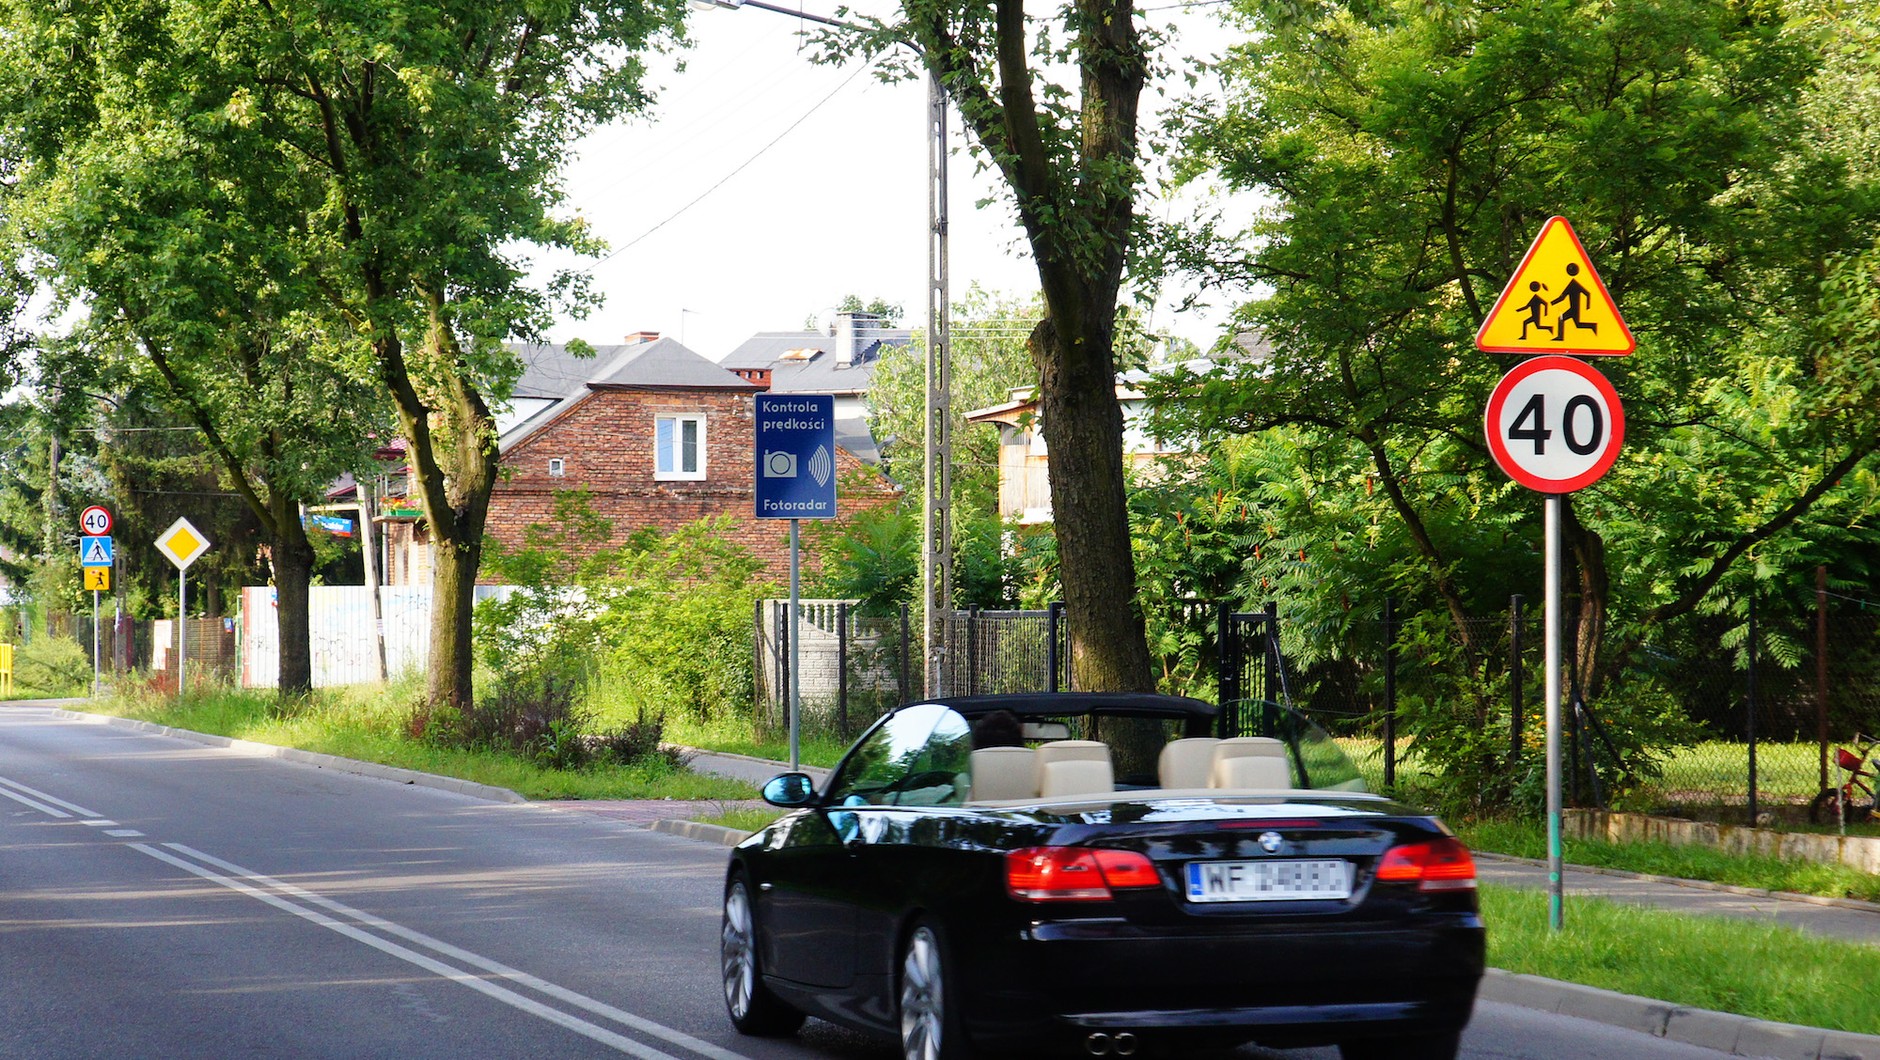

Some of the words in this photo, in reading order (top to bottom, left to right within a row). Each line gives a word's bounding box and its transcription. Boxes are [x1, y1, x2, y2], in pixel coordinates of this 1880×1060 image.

[763, 401, 818, 412] Kontrola
[763, 417, 825, 432] prędkości
[1508, 393, 1603, 456] 40
[764, 499, 827, 511] Fotoradar
[85, 514, 107, 529] 40
